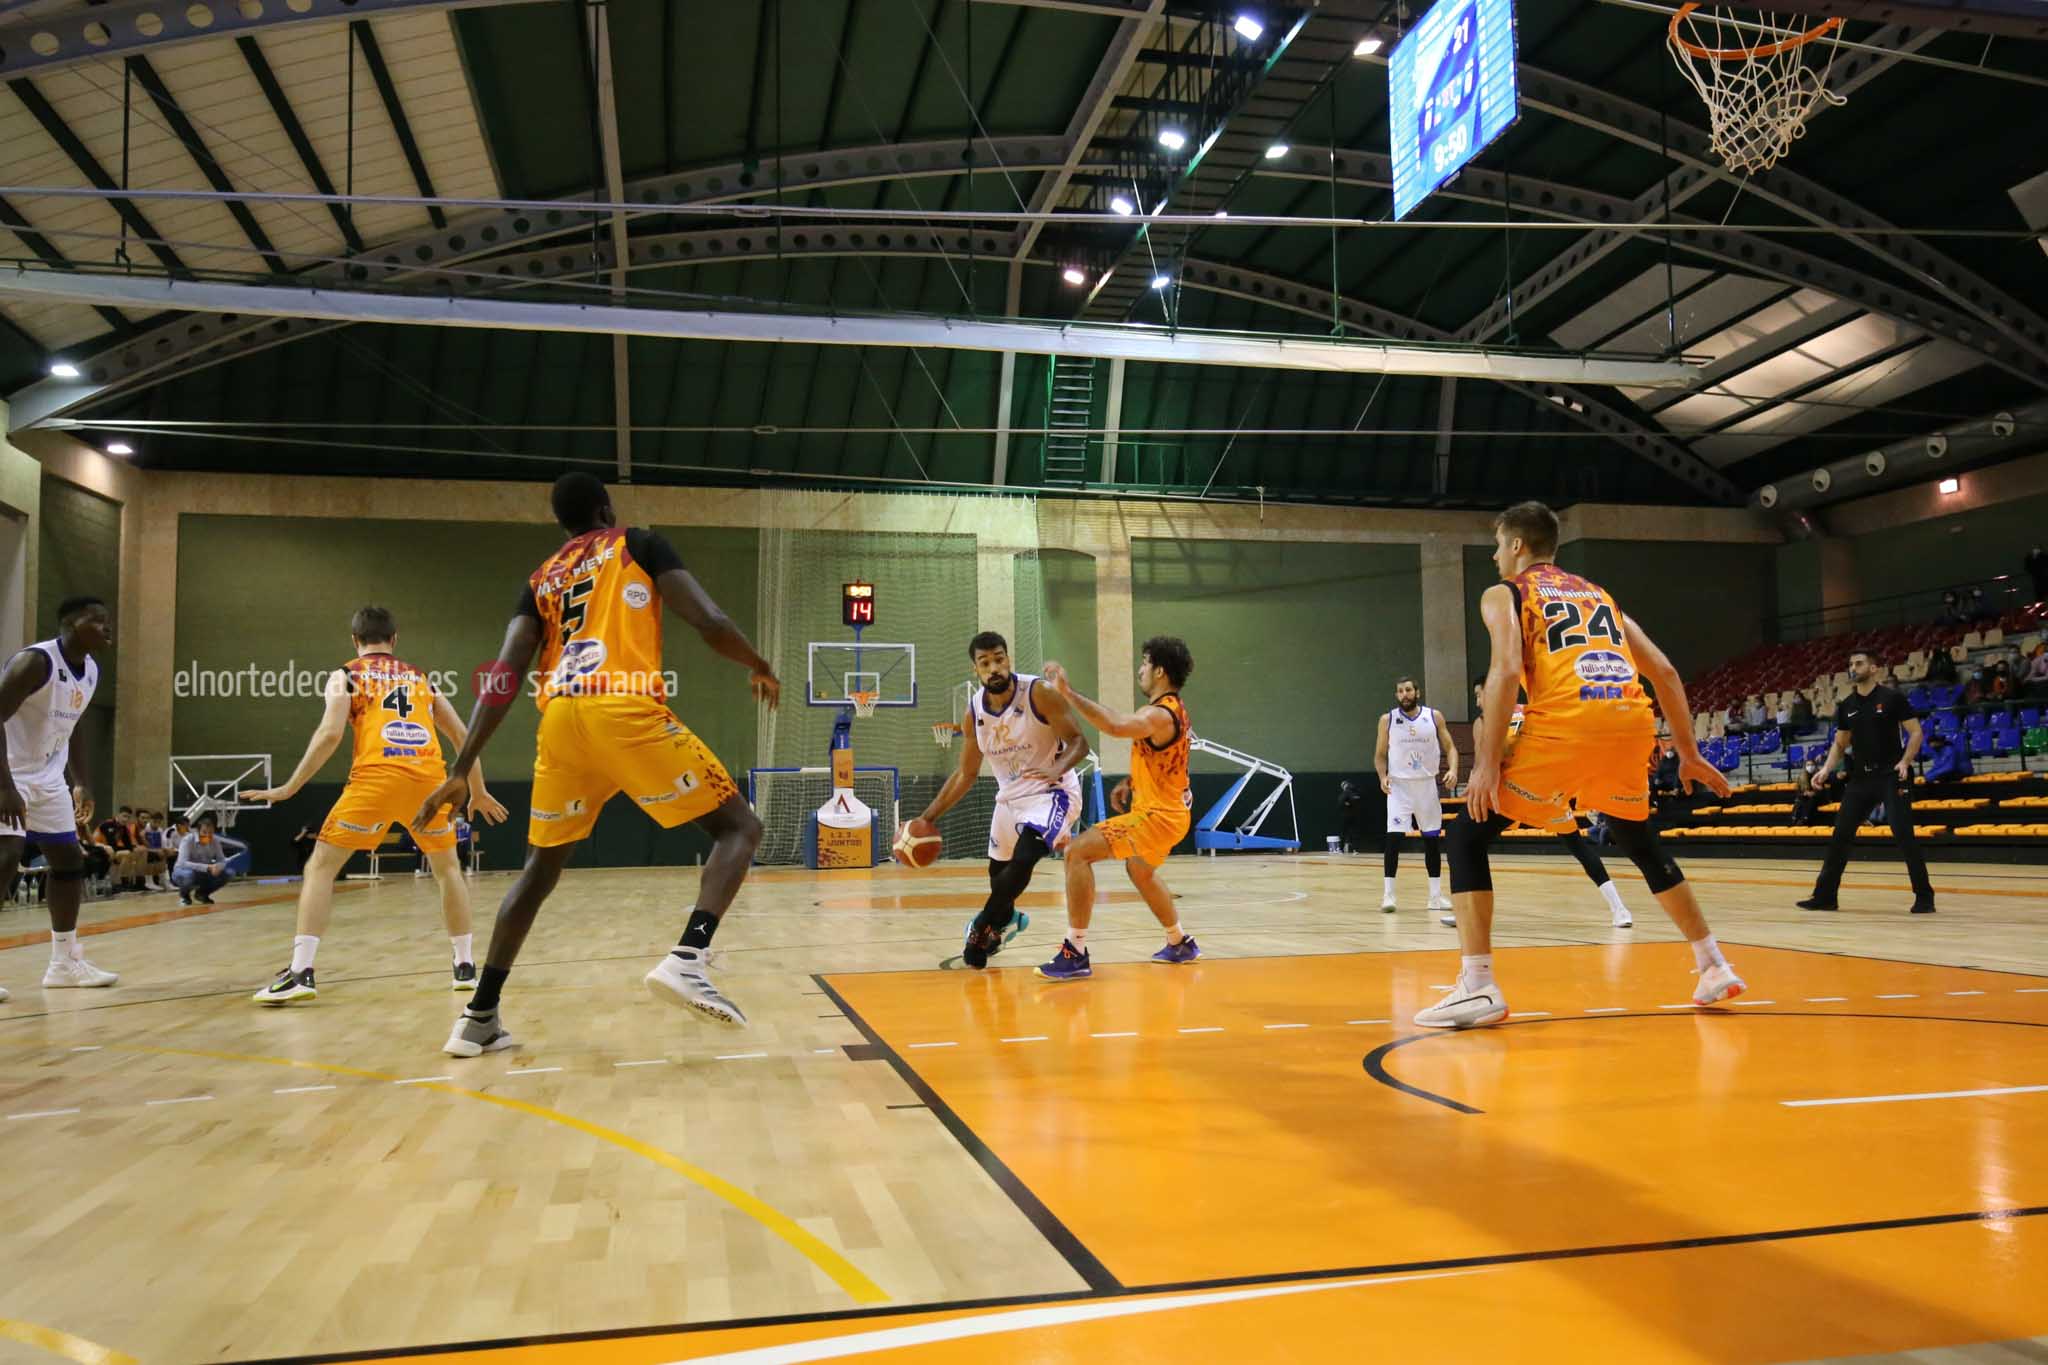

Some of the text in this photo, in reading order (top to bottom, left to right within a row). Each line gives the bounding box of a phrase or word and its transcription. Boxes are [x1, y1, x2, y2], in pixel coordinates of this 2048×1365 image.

[1434, 123, 1468, 173] 9:50
[560, 575, 596, 646] 5
[852, 602, 872, 621] 14
[1543, 600, 1624, 655] 24
[381, 684, 414, 719] 4
